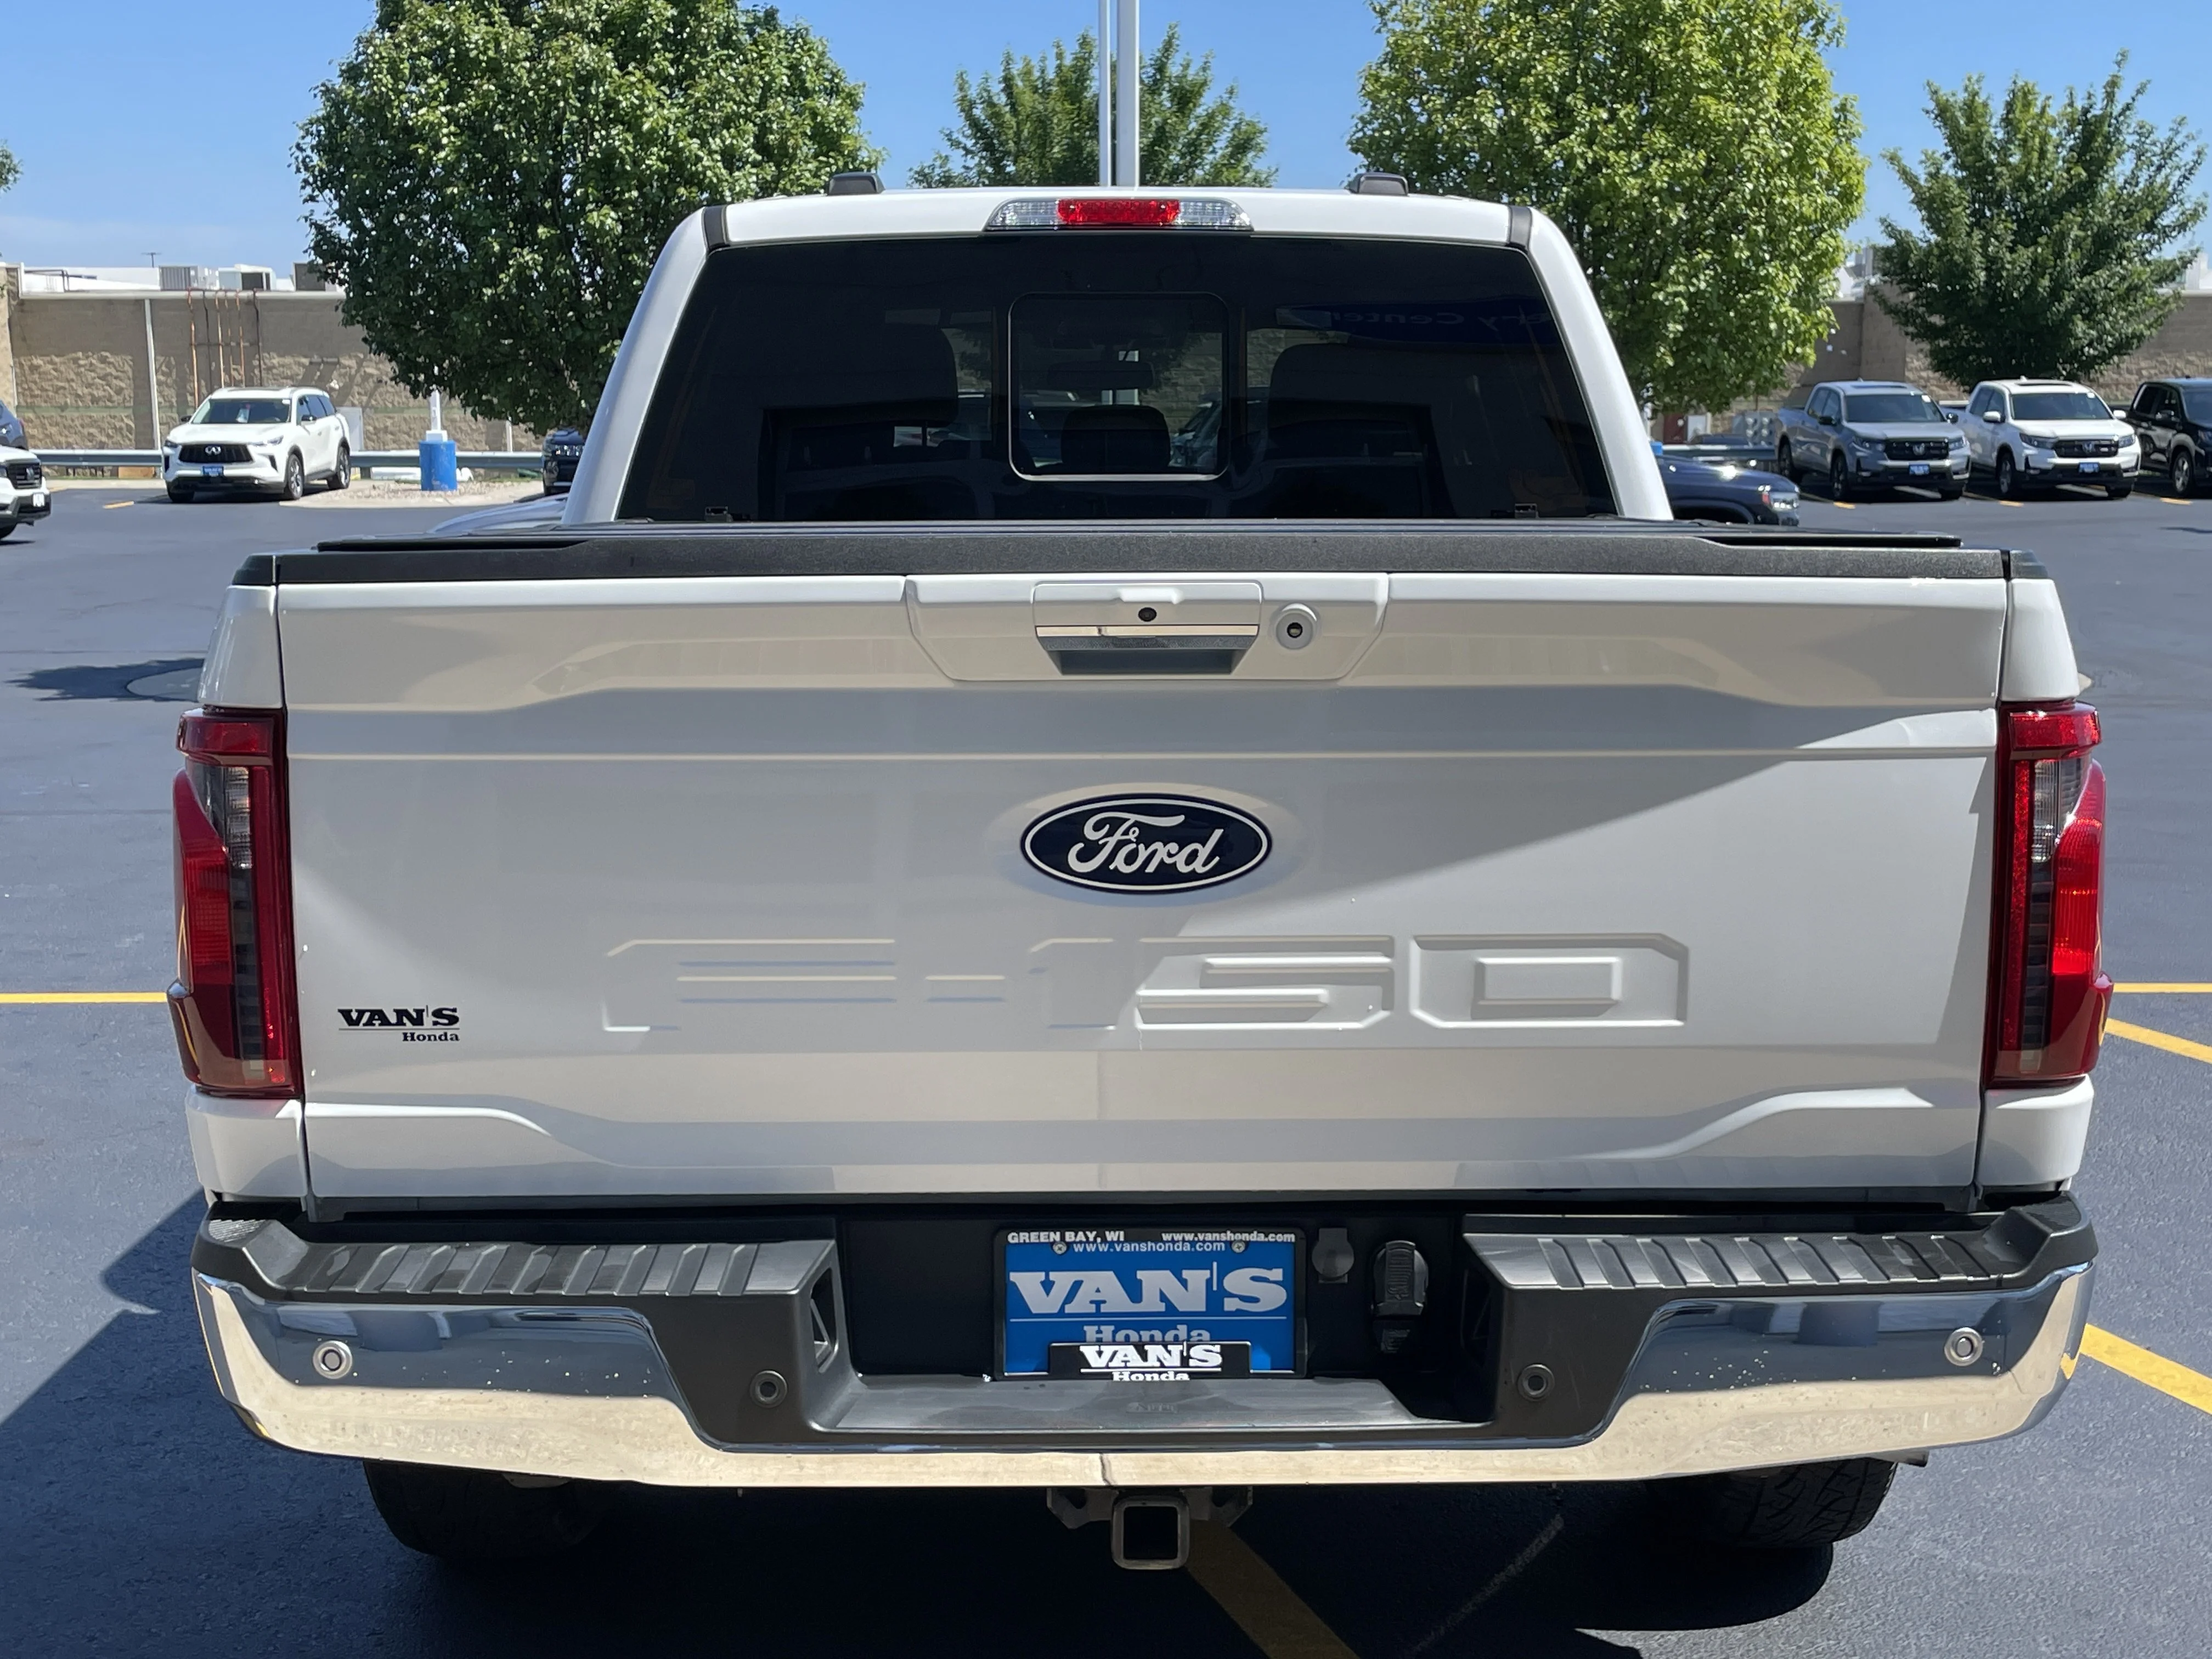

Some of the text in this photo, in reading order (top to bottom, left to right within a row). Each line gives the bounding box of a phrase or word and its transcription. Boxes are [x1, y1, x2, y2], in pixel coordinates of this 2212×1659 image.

[1068, 811, 1224, 873] Ford
[337, 1005, 460, 1027] VAN'S
[402, 1031, 460, 1042] Honda
[1007, 1231, 1125, 1244] GREEN BAY, WI
[1161, 1230, 1295, 1243] www.vanshonda.com
[1073, 1240, 1225, 1252] www.vanshonda.com
[1009, 1261, 1288, 1314] VAN'S
[1084, 1324, 1211, 1342] Honda
[1079, 1341, 1223, 1368] VAN'S
[1112, 1371, 1190, 1381] Honda
